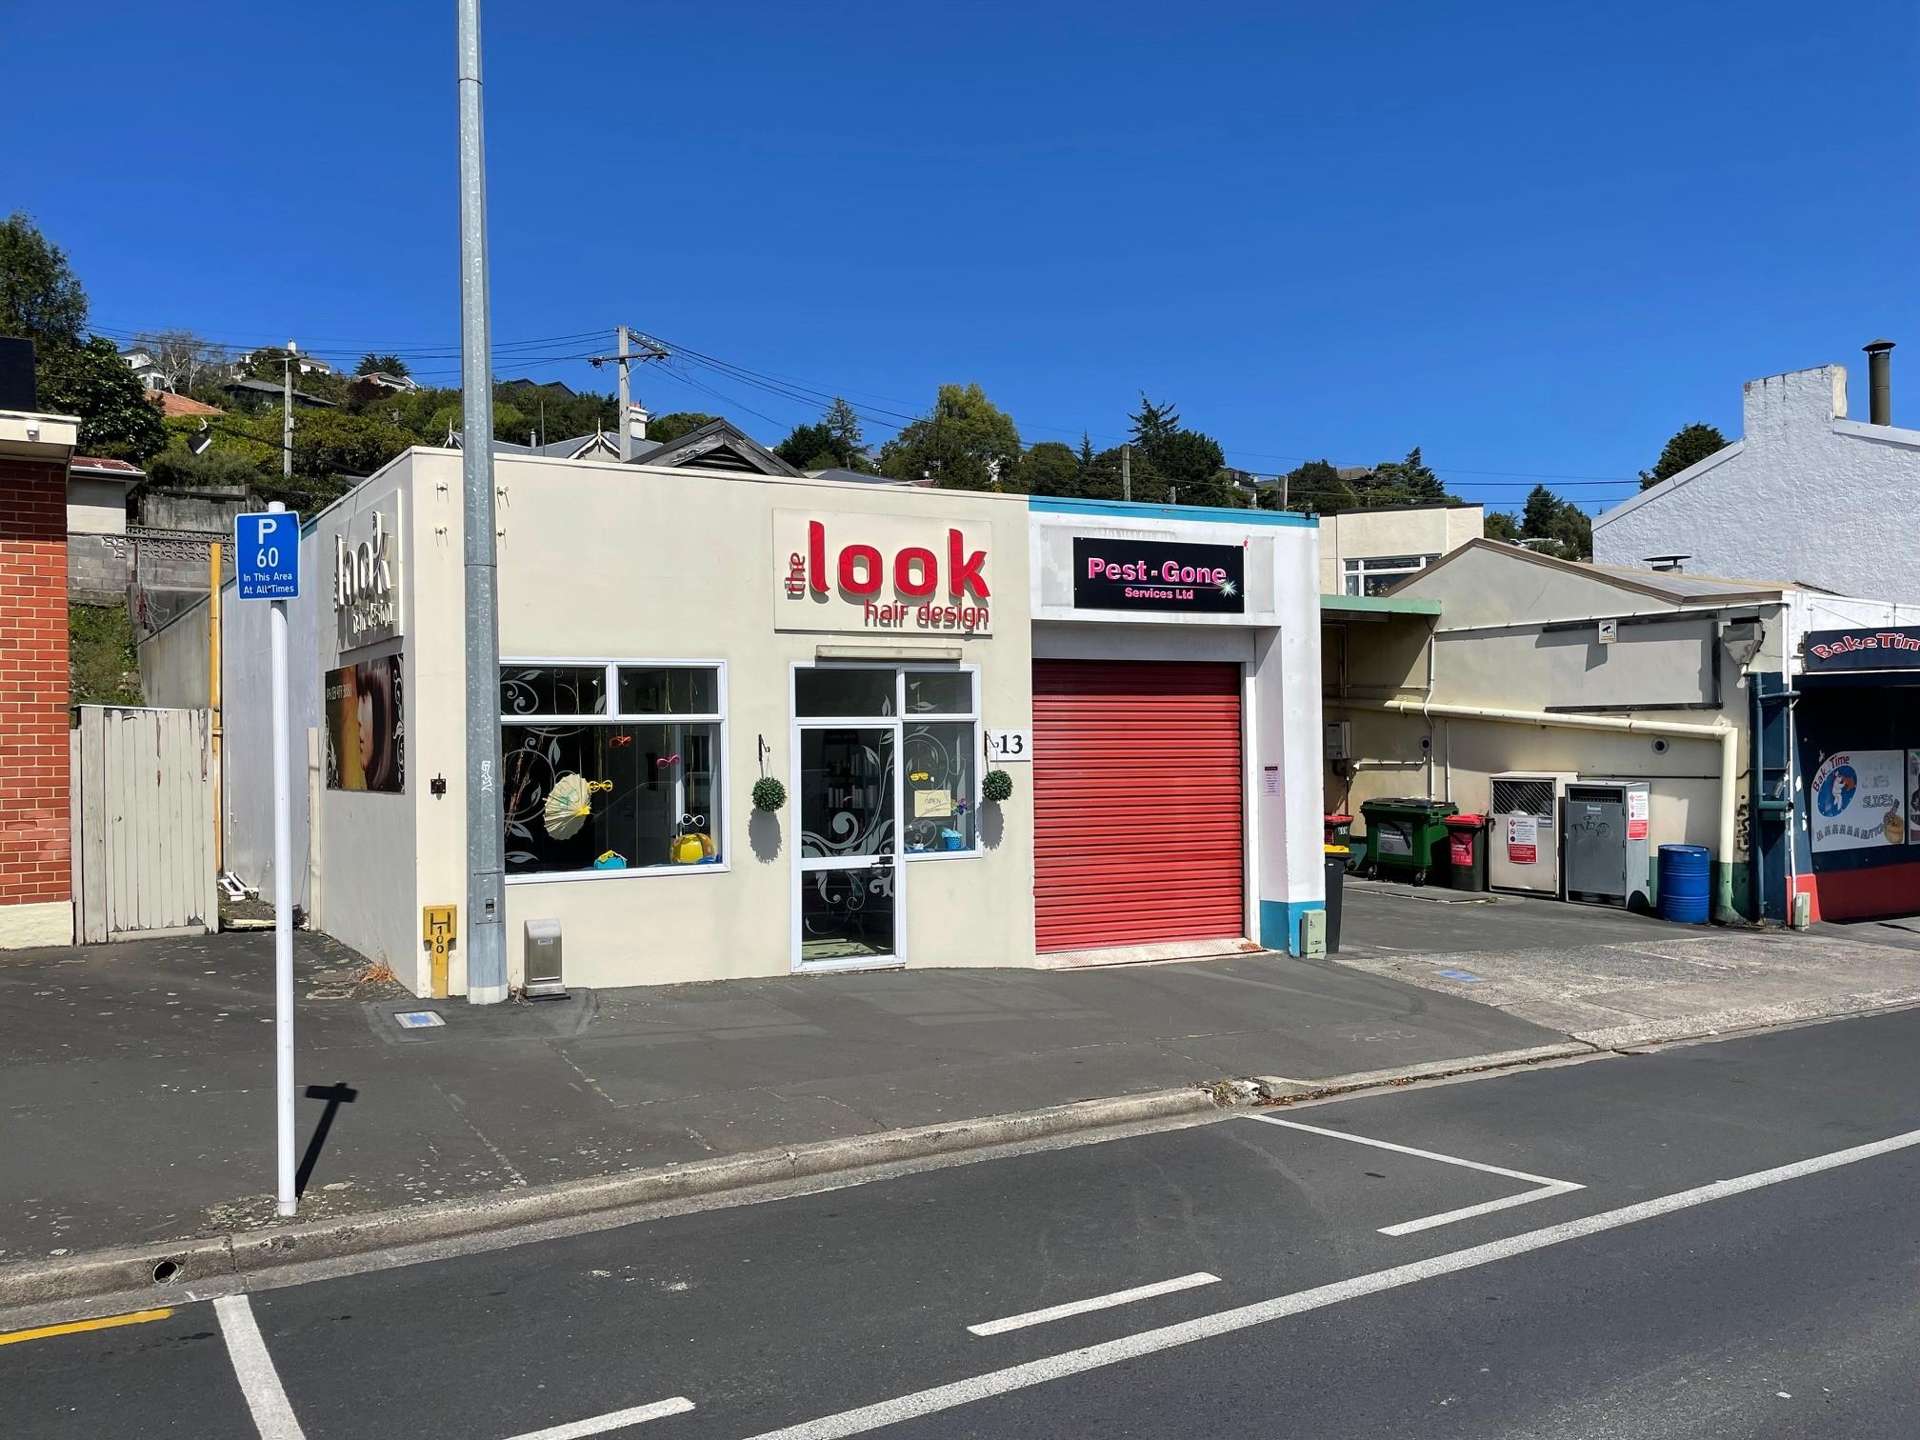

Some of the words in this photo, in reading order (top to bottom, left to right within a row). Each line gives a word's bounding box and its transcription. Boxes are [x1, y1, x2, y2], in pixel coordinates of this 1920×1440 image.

[258, 519, 277, 544] P
[256, 547, 279, 568] 60
[809, 520, 991, 598] look
[254, 572, 270, 581] This
[273, 572, 293, 581] Area
[784, 552, 805, 594] the
[243, 585, 253, 594] At
[256, 585, 268, 594] All
[270, 584, 295, 593] Times
[1125, 587, 1174, 600] Services
[1176, 588, 1194, 600] Ltd
[864, 600, 908, 622] hair
[917, 603, 989, 632] design
[1000, 735, 1023, 754] 13
[430, 912, 451, 935] H
